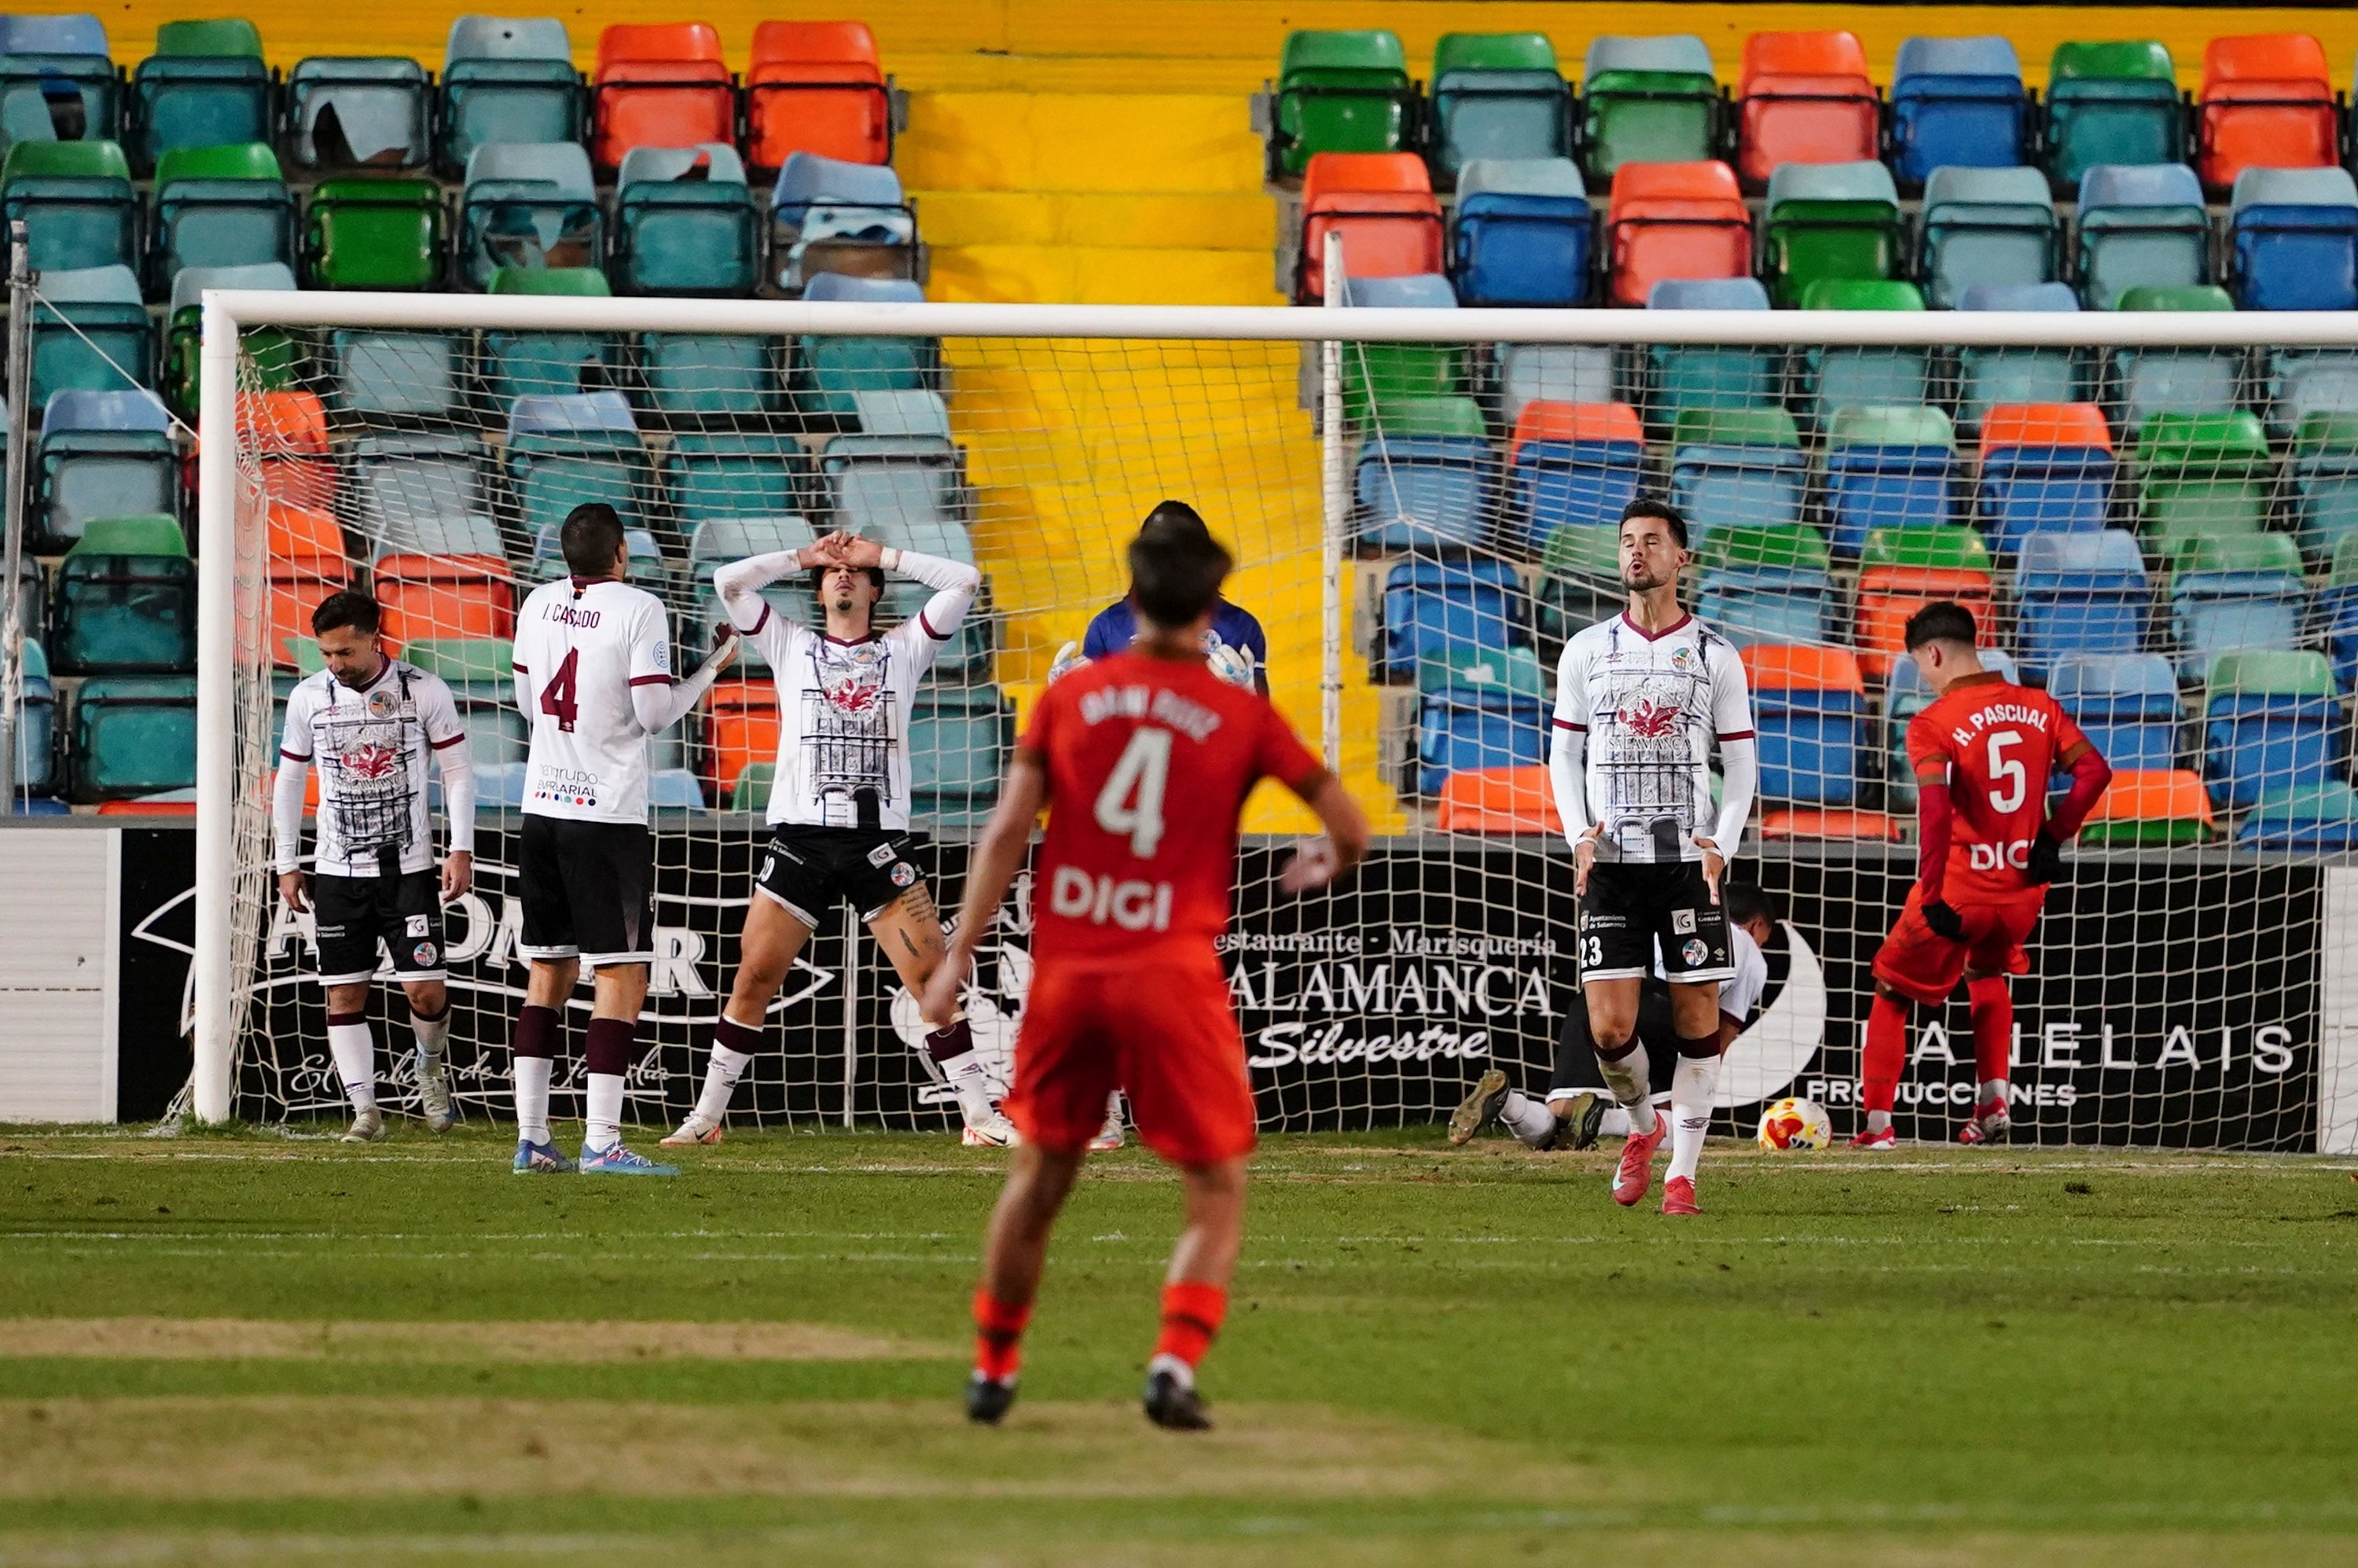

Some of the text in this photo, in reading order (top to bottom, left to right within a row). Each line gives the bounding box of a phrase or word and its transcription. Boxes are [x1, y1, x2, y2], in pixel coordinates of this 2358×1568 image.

[552, 604, 601, 629] CASADO
[540, 646, 578, 733] 4
[1952, 703, 2049, 747] H. PASCUAL
[1094, 725, 1173, 859] 4
[1987, 730, 2026, 813] 5
[1971, 839, 2037, 870] DIG
[1051, 864, 1174, 931] DIGI
[1213, 929, 1363, 953] estaurante
[1388, 928, 1557, 960] Marisquería
[1580, 935, 1603, 969] 23
[1227, 961, 1556, 1017] ALAMANCA
[1248, 1021, 1489, 1069] Silvestre
